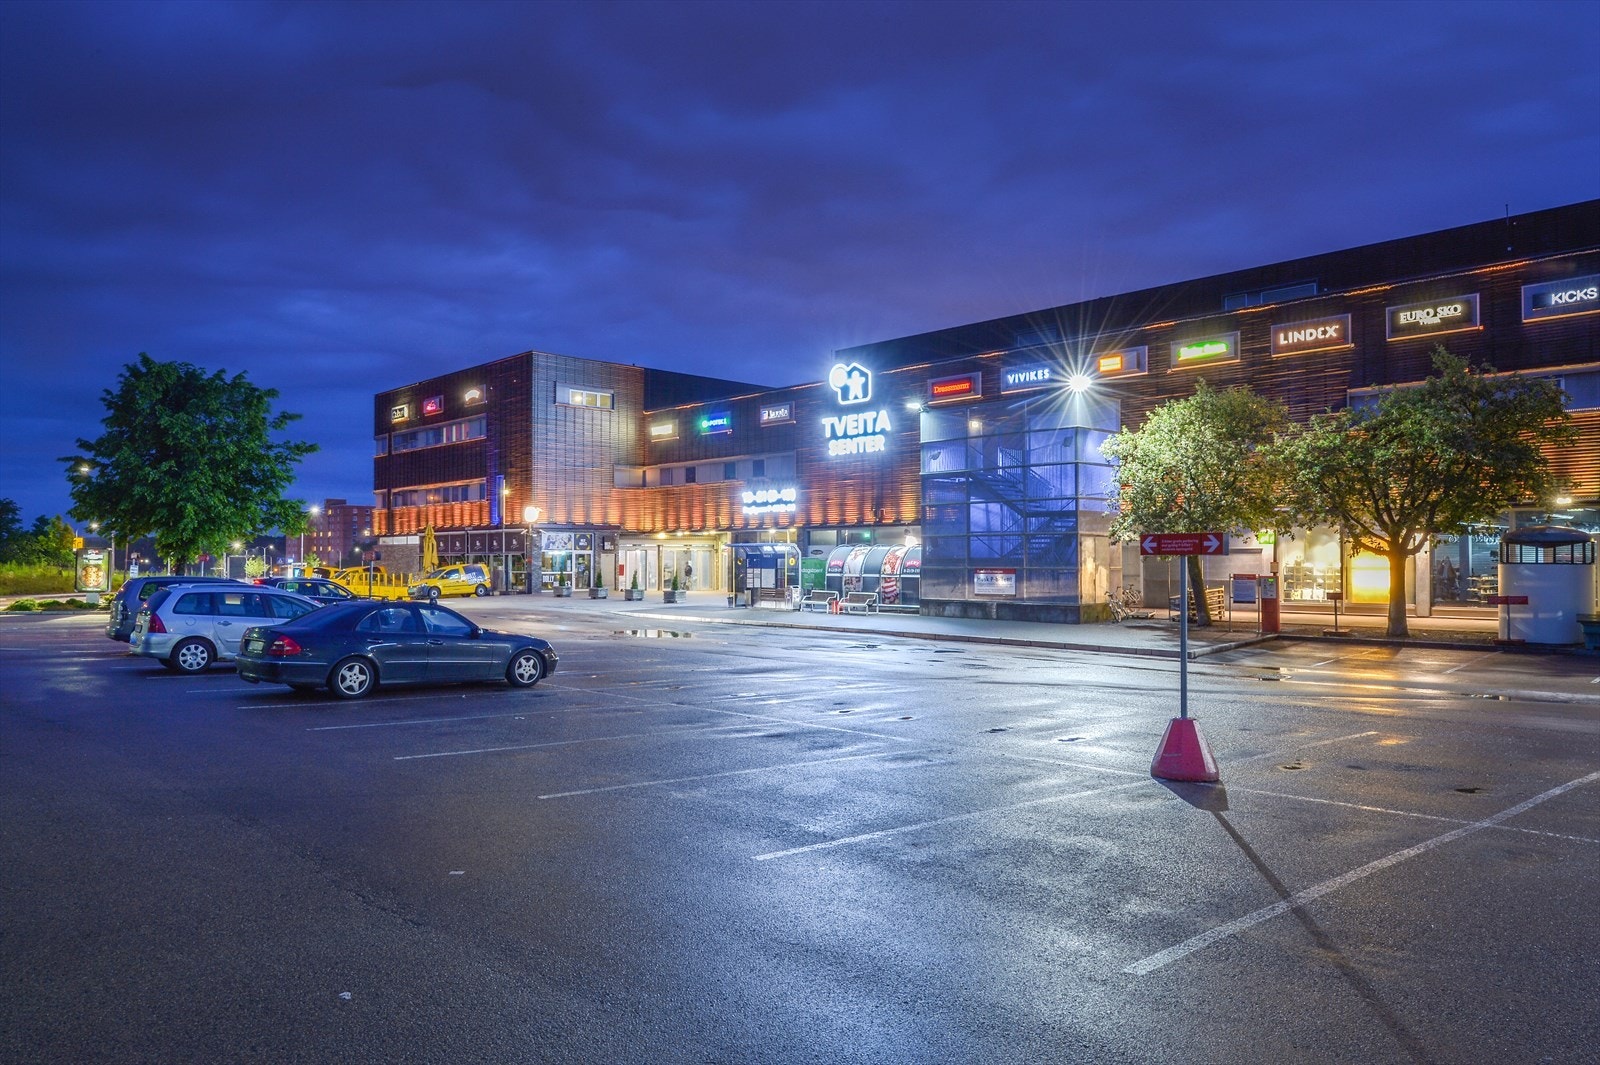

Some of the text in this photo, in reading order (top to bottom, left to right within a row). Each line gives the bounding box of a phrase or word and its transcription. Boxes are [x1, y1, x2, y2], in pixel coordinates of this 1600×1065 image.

[1552, 287, 1598, 305] KICKS
[1400, 304, 1462, 322] EURO SKO
[1279, 326, 1338, 344] LINDEX
[1007, 369, 1049, 384] VIVIKES
[821, 410, 891, 437] TVEITA
[828, 435, 885, 455] SENTER
